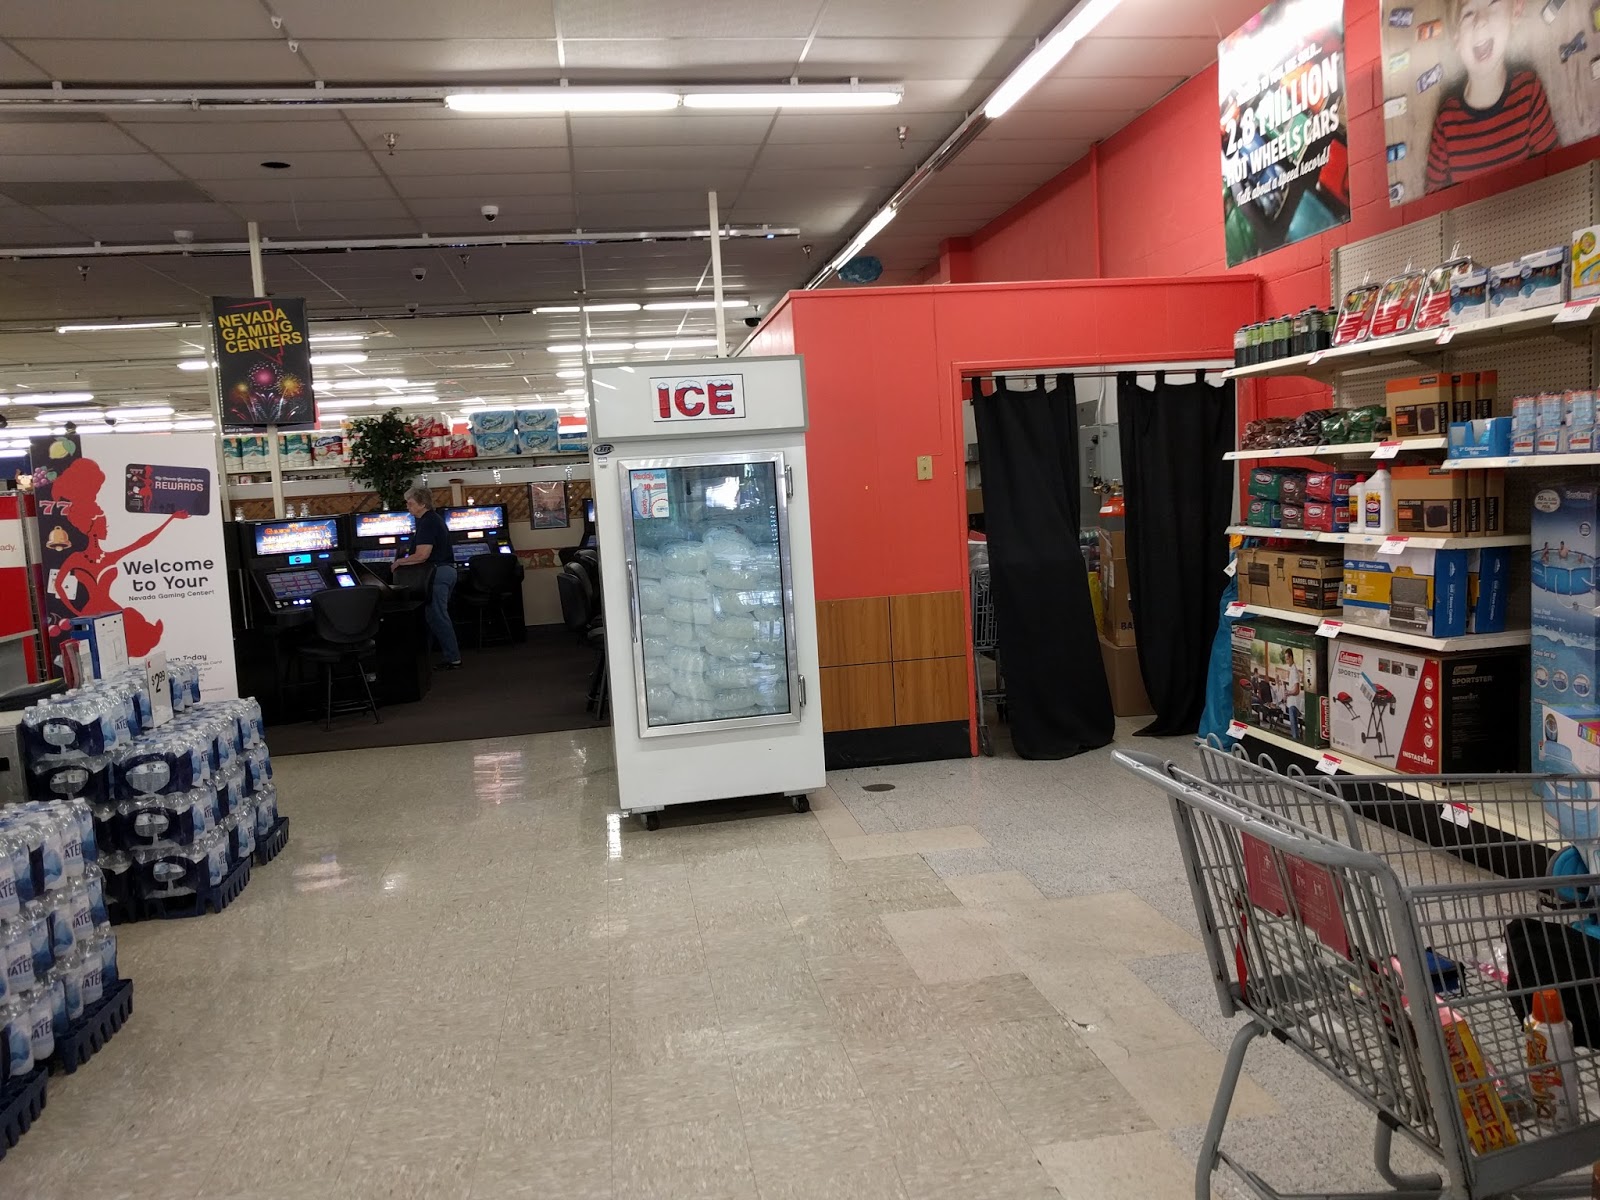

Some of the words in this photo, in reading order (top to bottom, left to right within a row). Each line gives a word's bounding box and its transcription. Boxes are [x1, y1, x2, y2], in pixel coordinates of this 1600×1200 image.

[1226, 107, 1257, 157] 2.8
[1255, 51, 1340, 137] MILLION
[1226, 152, 1249, 188] HOT
[1250, 122, 1303, 174] WHEELS
[1303, 101, 1340, 143] CARS
[1251, 181, 1271, 201] about
[218, 308, 287, 328] NEVADA
[222, 320, 293, 340] GAMING
[226, 332, 303, 353] CENTERS
[657, 379, 735, 418] ICE
[155, 481, 204, 491] REWARDS
[0, 544, 16, 552] ady.
[123, 558, 214, 575] Welcome
[133, 580, 156, 591] to
[163, 575, 209, 590] Your
[1292, 577, 1308, 585] BARREL
[158, 591, 185, 600] Gaming
[1121, 622, 1133, 630] BA
[1340, 652, 1363, 664] Coleman
[1338, 668, 1360, 678] SPORTST
[1452, 675, 1492, 685] SPORTSTER
[1403, 751, 1434, 765] INSTASTART
